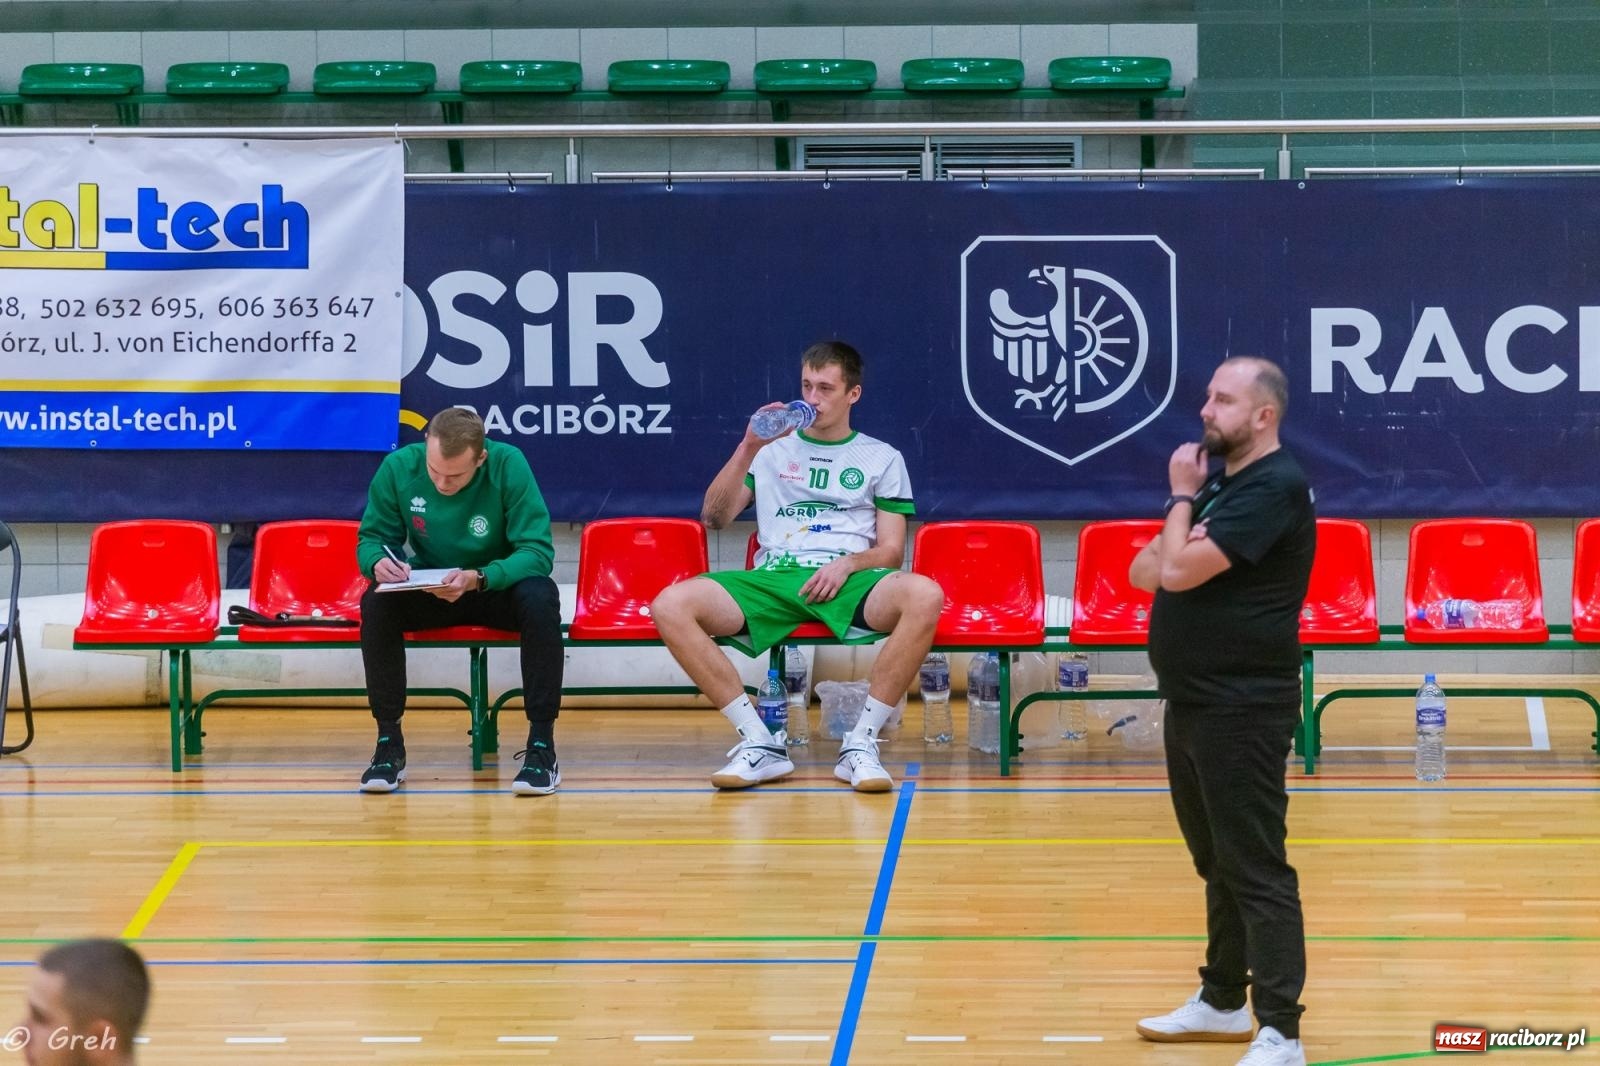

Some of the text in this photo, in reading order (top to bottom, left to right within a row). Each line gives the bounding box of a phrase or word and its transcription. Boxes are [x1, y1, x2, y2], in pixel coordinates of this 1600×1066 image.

[0, 296, 374, 320] 8, 502 632 695, 606 363 647
[403, 270, 671, 389] SiR
[55, 331, 84, 353] ul.
[92, 332, 109, 353] J.
[117, 337, 163, 353] von
[173, 331, 334, 353] Eichendorffa
[343, 333, 357, 353] 2
[809, 467, 830, 489] 10
